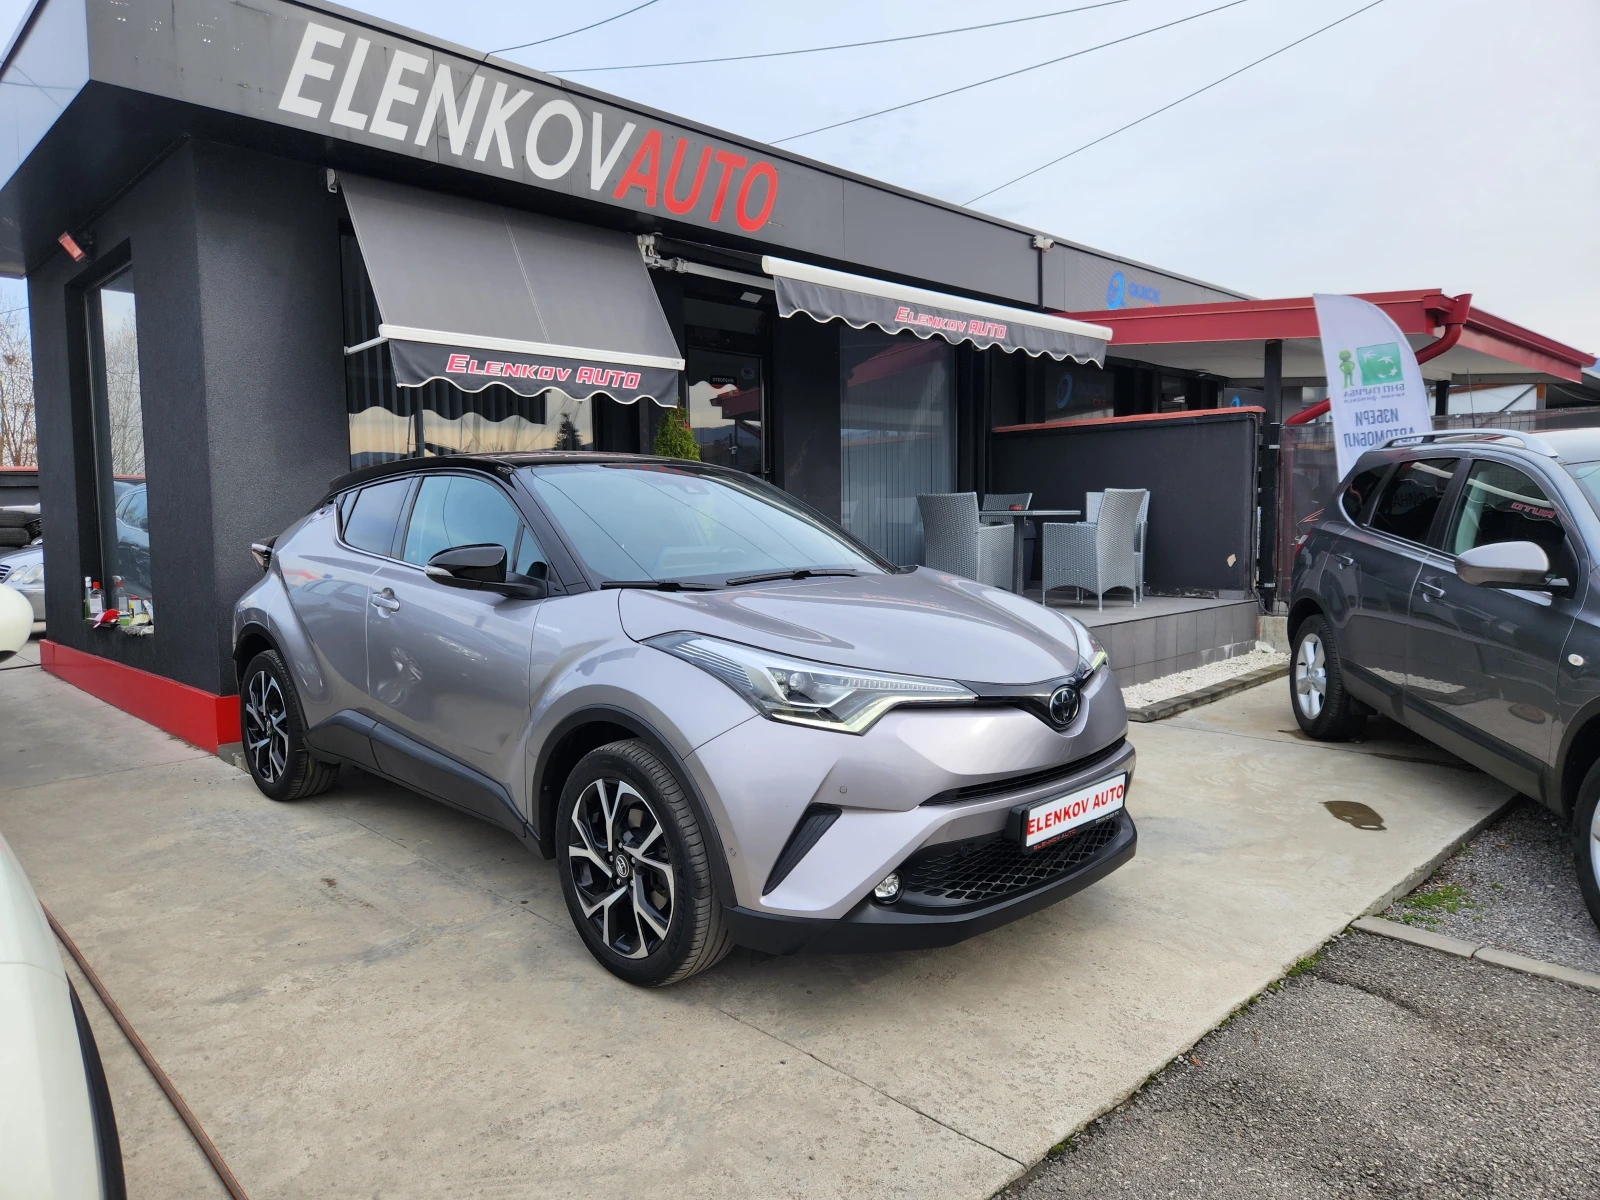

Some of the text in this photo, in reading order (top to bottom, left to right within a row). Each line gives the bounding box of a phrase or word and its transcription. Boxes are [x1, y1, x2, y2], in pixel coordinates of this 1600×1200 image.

[895, 306, 1007, 339] ELENKOV AUTO
[446, 353, 641, 389] ELENKOV AUTO
[1027, 798, 1089, 836] ELENKOV
[1092, 784, 1124, 809] AUTO
